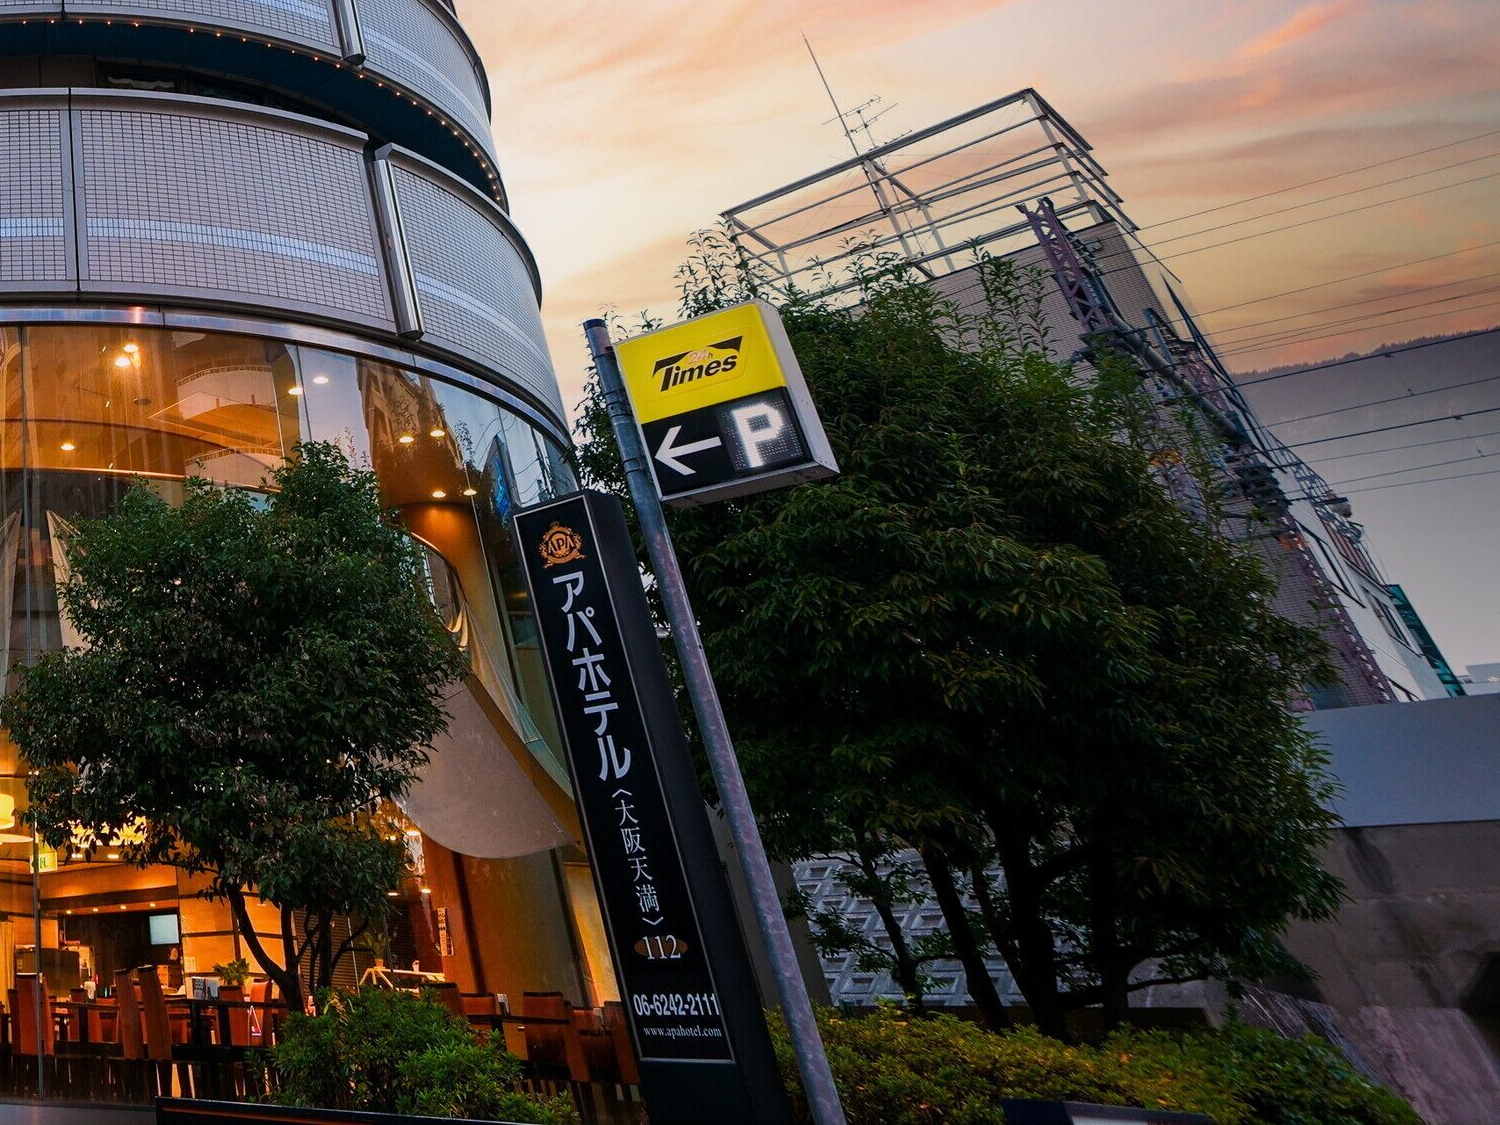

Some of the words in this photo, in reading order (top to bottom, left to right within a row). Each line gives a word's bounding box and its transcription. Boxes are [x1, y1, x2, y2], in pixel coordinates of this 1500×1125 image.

[652, 336, 743, 392] Times
[731, 403, 784, 468] P
[548, 536, 575, 554] APA
[553, 571, 631, 781] アパホテル
[642, 935, 681, 960] 112
[633, 993, 720, 1016] 06-6242-2111
[643, 1025, 722, 1039] www.apahotel.com
